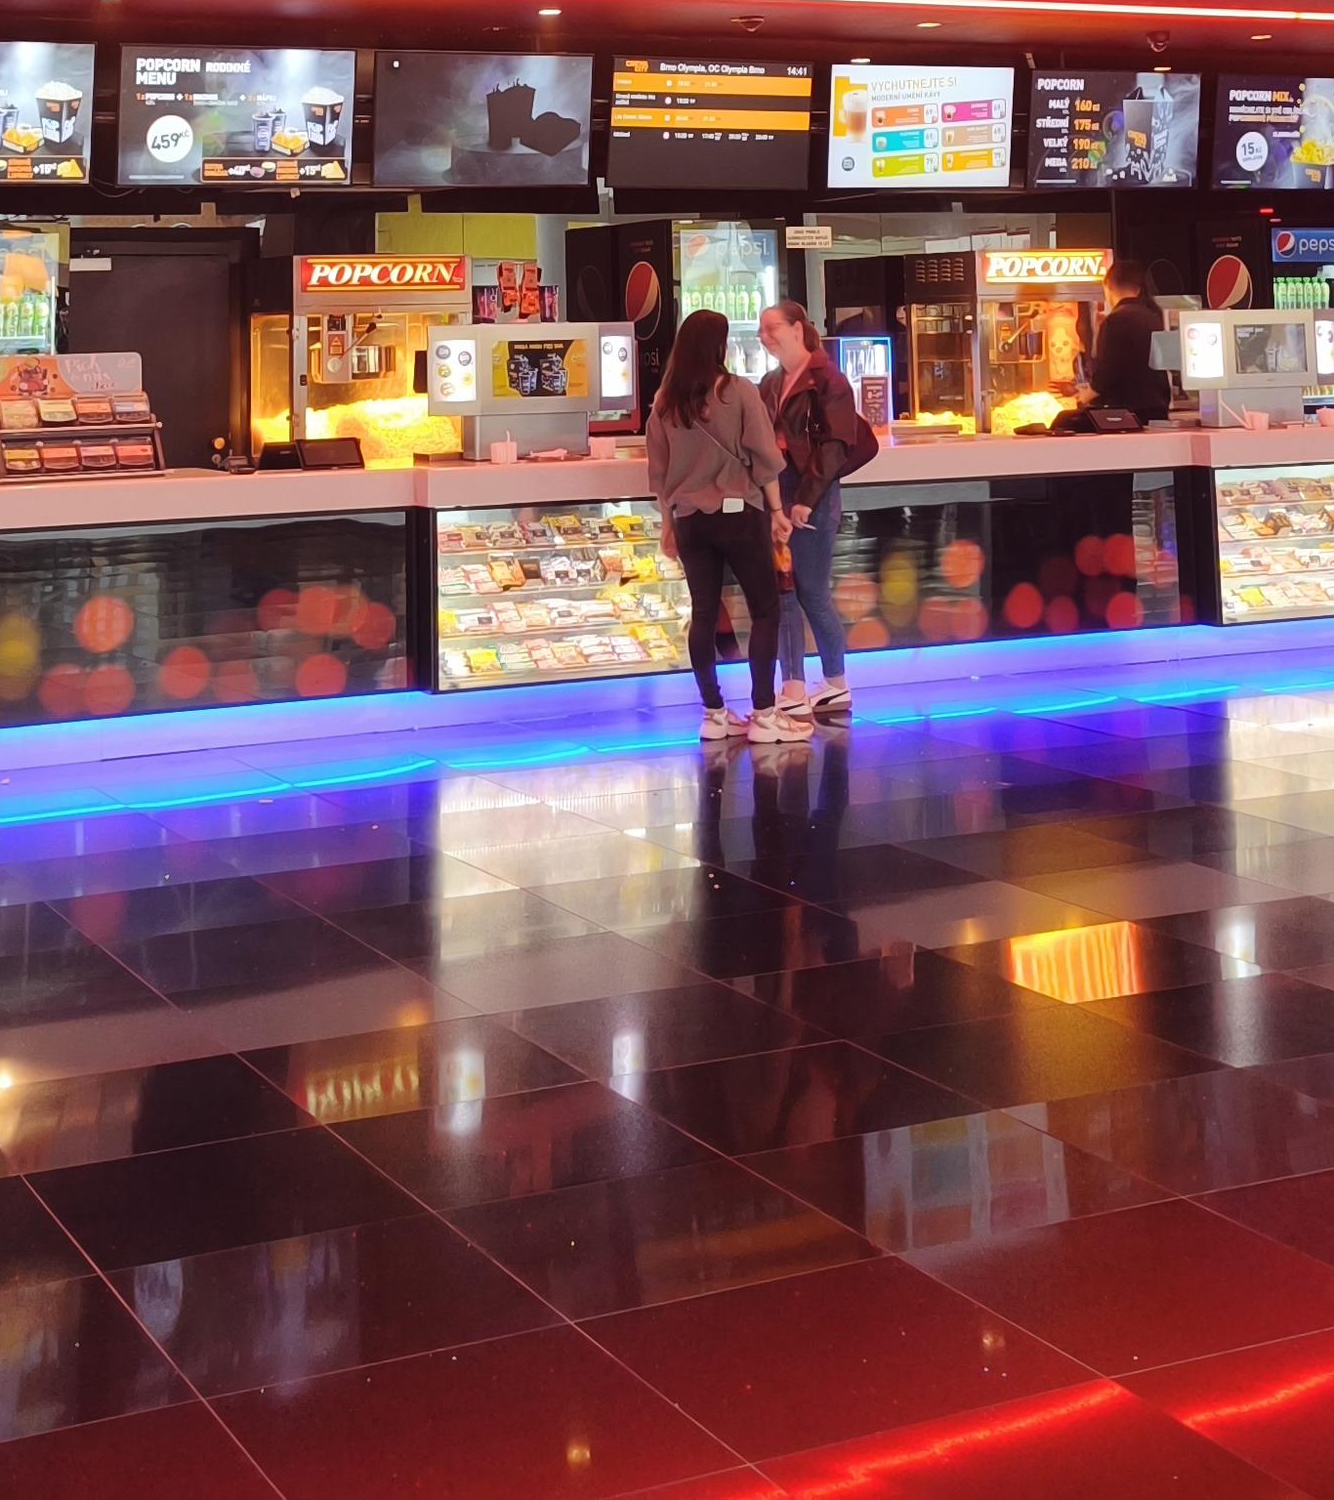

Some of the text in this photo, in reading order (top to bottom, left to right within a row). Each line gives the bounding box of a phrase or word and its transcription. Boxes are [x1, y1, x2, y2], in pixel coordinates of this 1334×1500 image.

[136, 58, 200, 72] POPCORN
[786, 67, 808, 76] 14:41
[136, 71, 176, 85] MENU
[871, 78, 948, 92] VYCHUTNEJTE
[1037, 79, 1084, 91] POPCORN
[1229, 90, 1272, 102] POPCORN
[1074, 100, 1092, 112] 160
[1073, 119, 1091, 130] 175
[151, 133, 179, 150] 459
[1073, 138, 1090, 150] 190
[1241, 142, 1255, 156] 15
[1071, 158, 1089, 170] 210
[987, 253, 1100, 278] POPCORN
[308, 261, 458, 287] POPCORN
